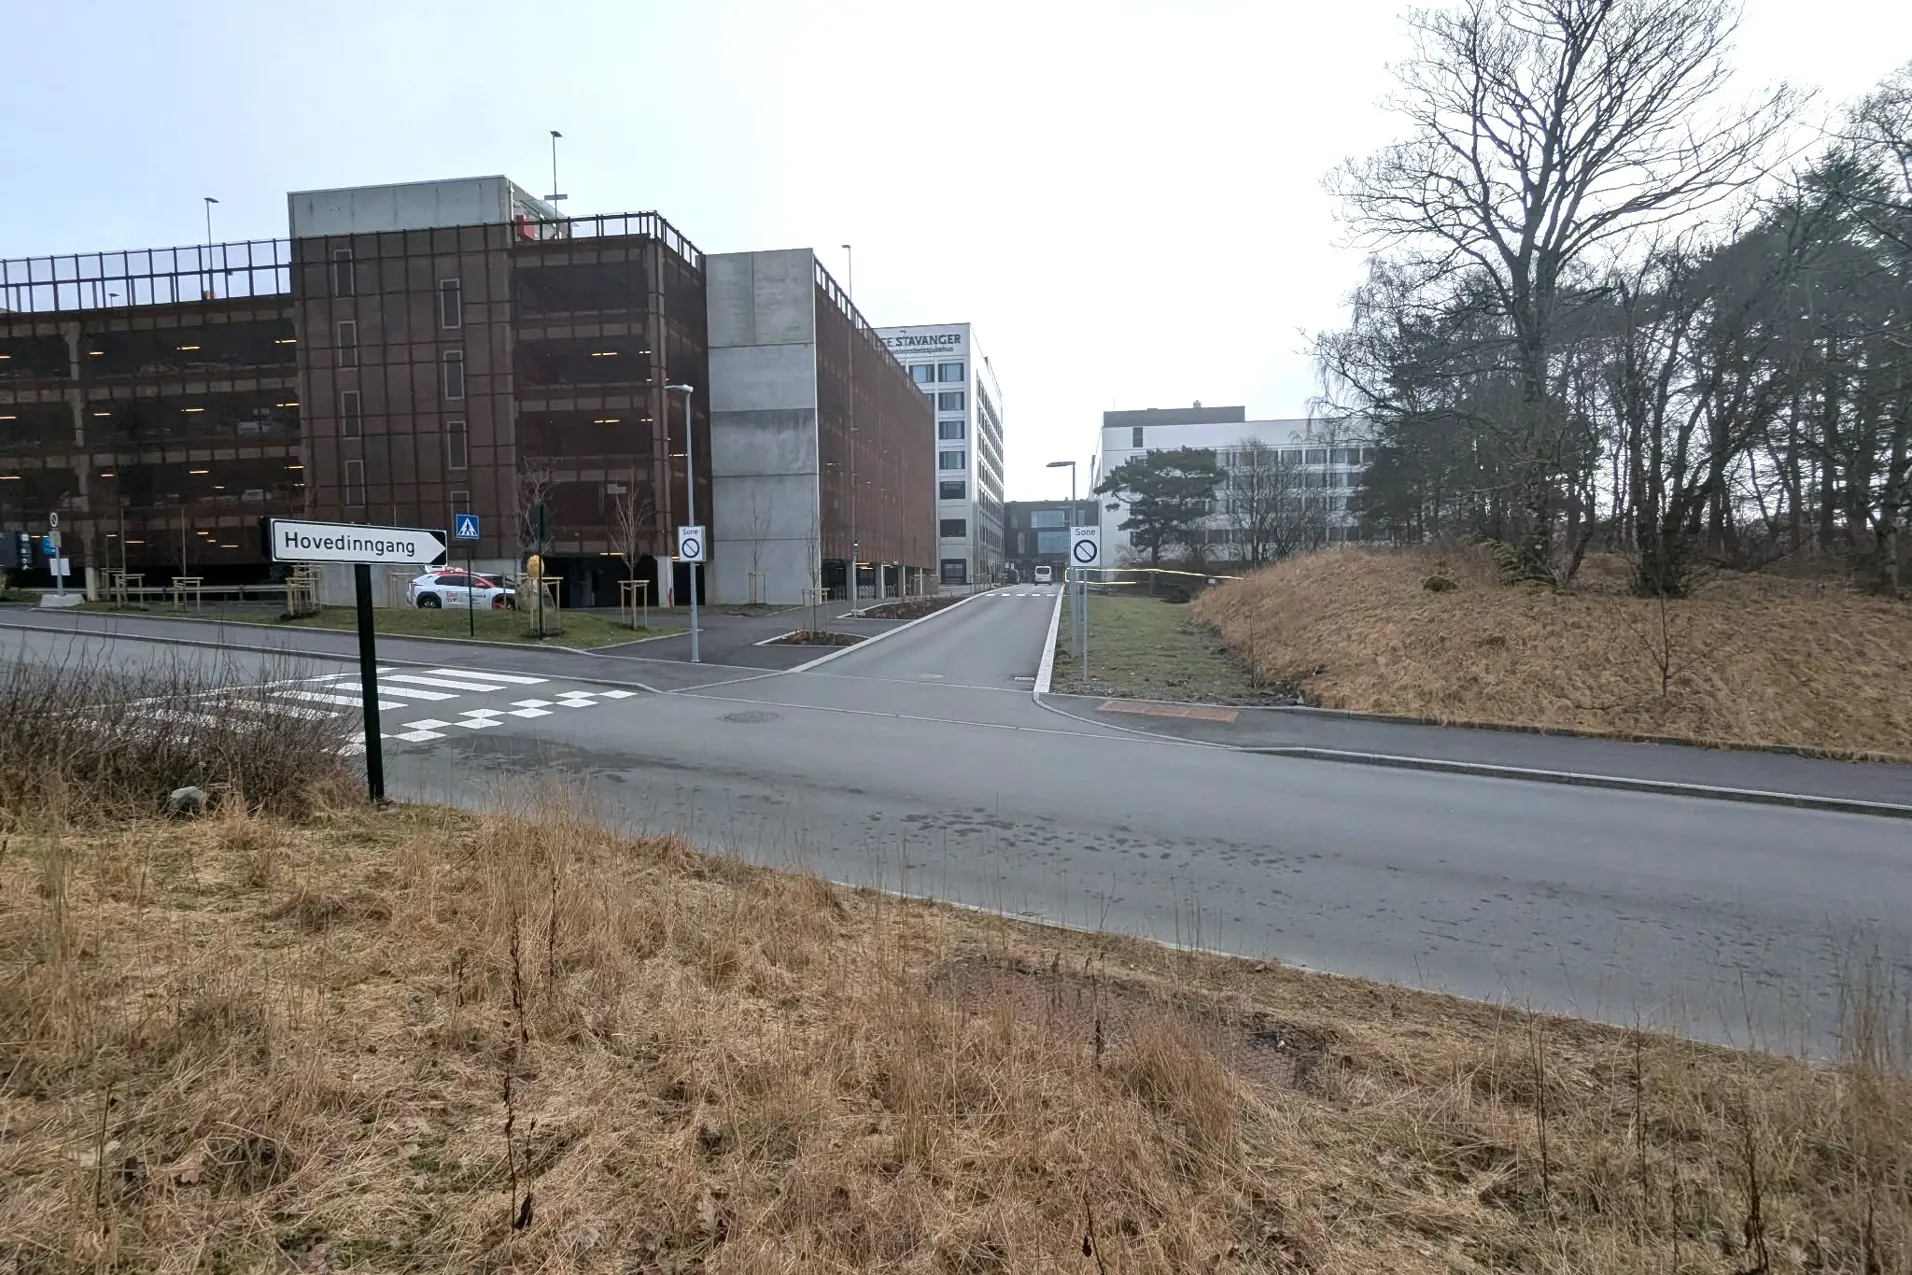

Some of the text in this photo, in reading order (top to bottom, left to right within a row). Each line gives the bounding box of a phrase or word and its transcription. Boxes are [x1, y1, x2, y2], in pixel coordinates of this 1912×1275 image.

[896, 334, 961, 347] STAVANGER
[1075, 528, 1096, 536] Sone
[284, 531, 416, 557] Hovedinngang
